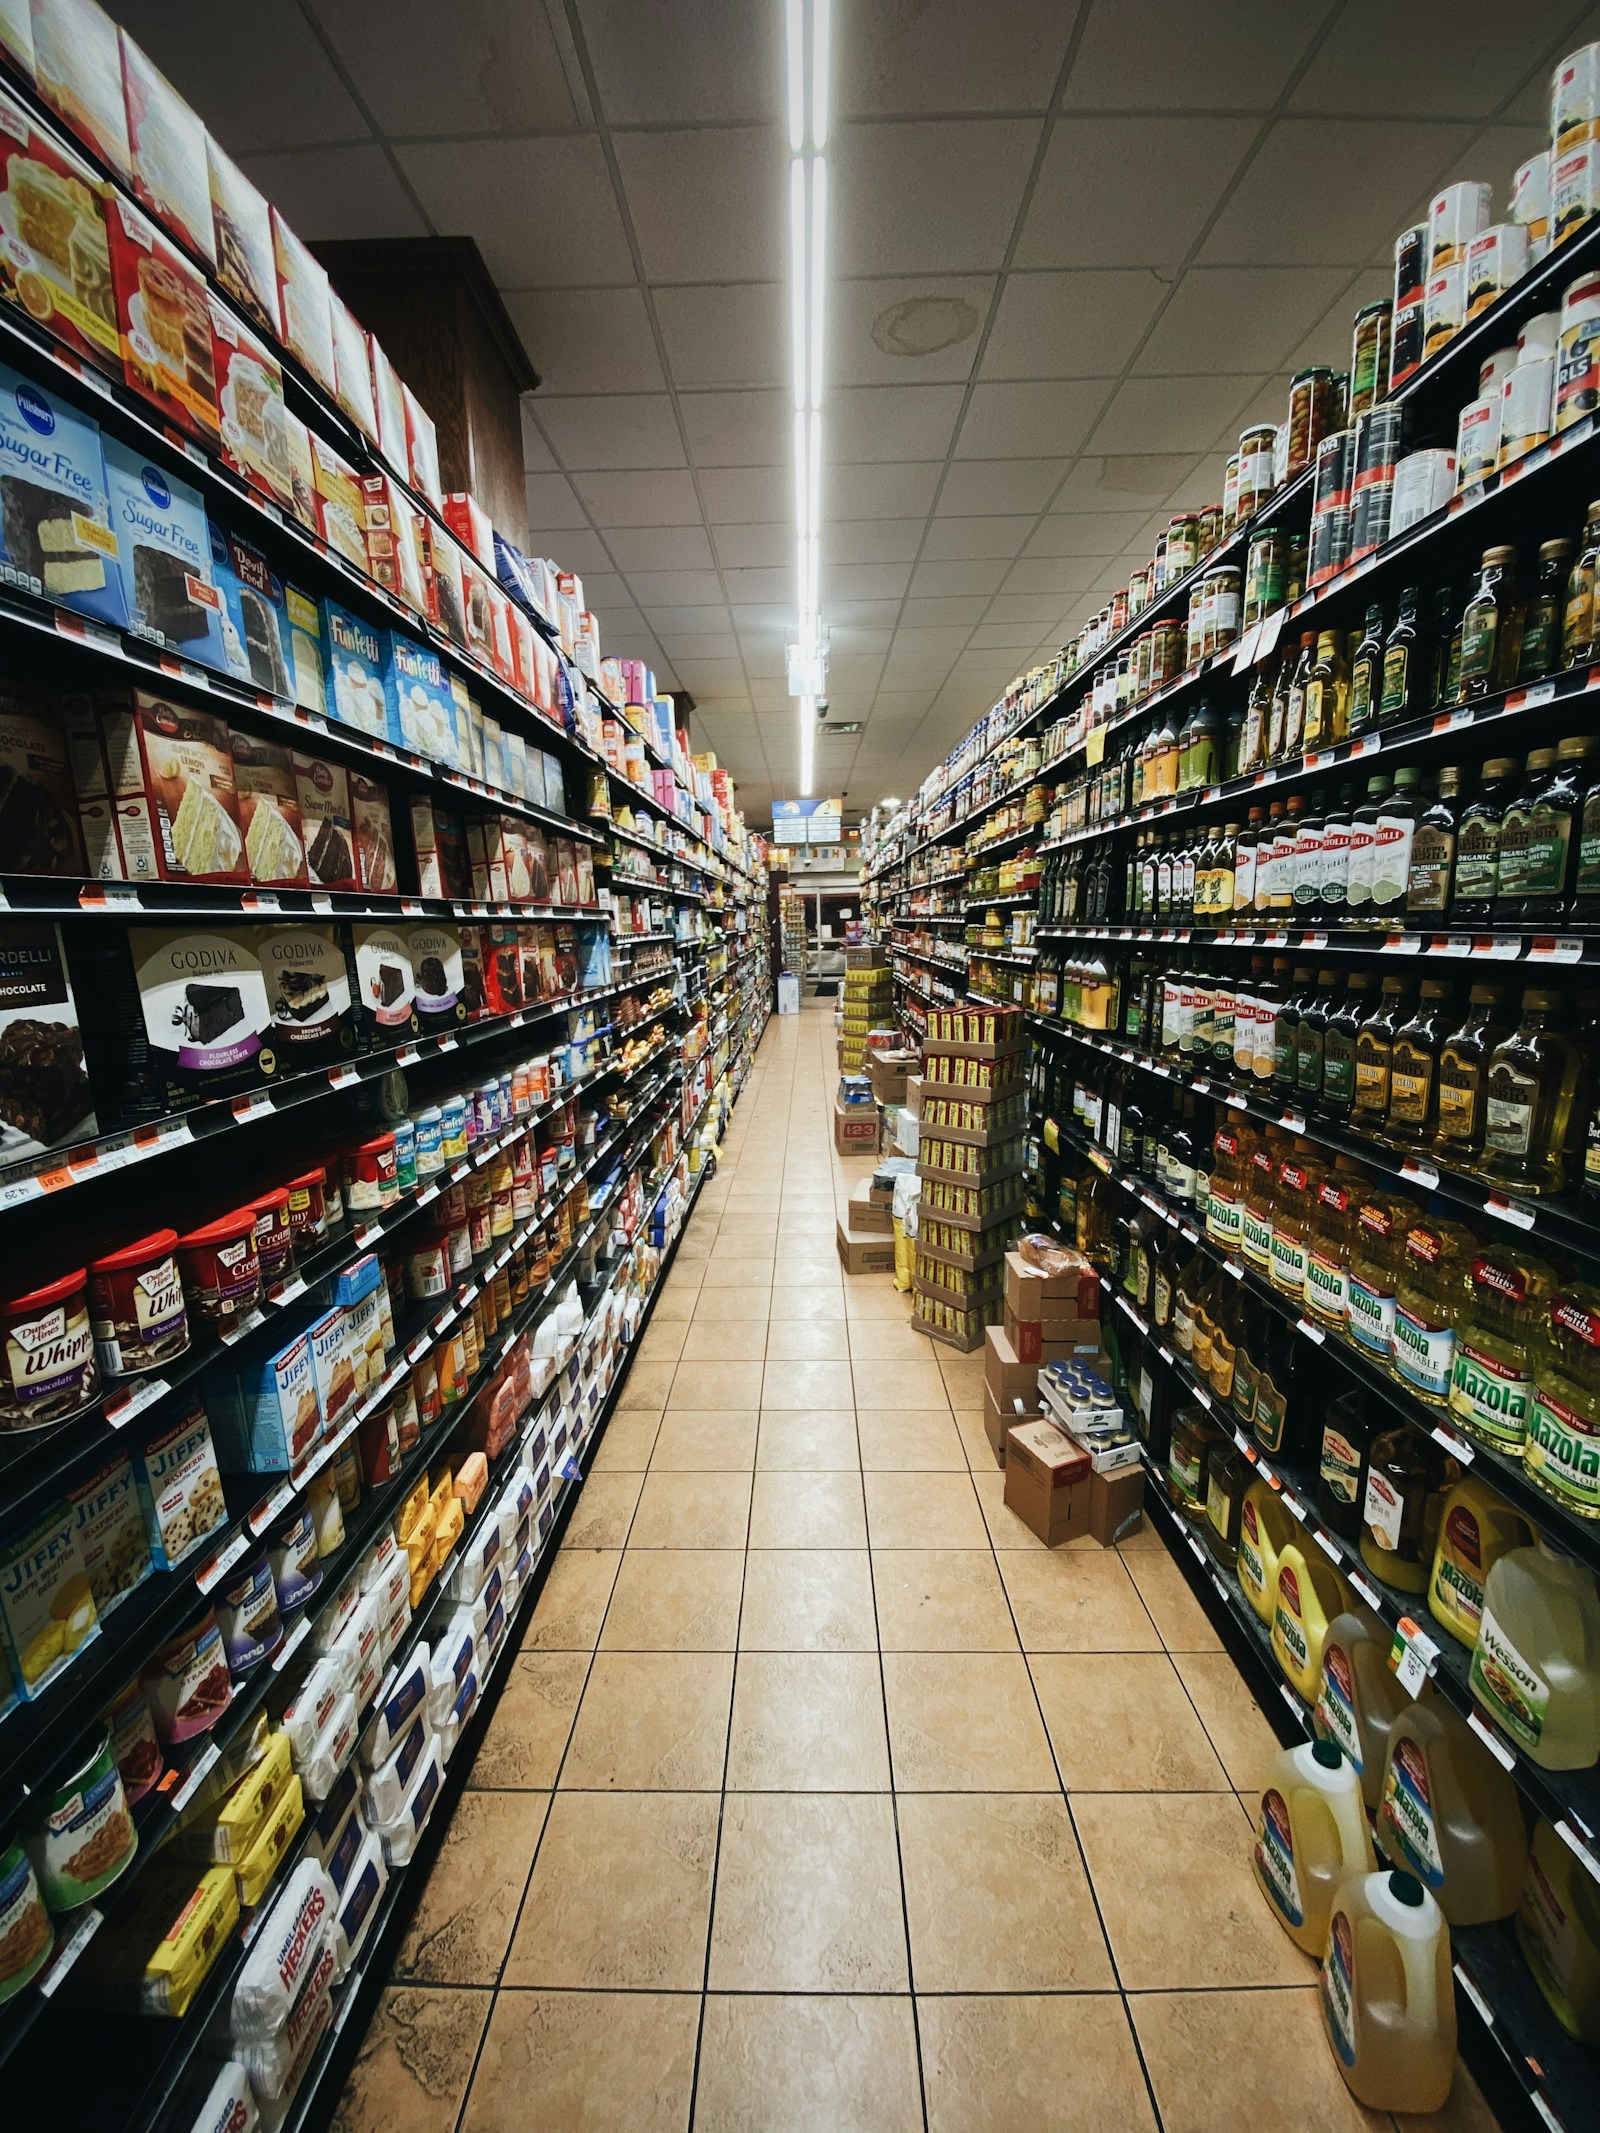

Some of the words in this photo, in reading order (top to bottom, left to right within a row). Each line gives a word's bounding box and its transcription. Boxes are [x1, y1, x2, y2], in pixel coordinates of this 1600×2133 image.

[18, 394, 54, 427] Pillsbury
[0, 422, 50, 465] Sugar
[52, 451, 93, 492] Free
[123, 500, 170, 535] Sugar
[170, 523, 201, 556] Free
[233, 546, 269, 580] Devil's
[240, 563, 264, 590] Food
[331, 613, 380, 664] Funfetti
[395, 644, 440, 687] Funfetti
[181, 756, 205, 769] LEMON
[304, 794, 325, 812] Super
[823, 803, 832, 815] 2
[1457, 853, 1492, 862] ORGANIC
[171, 949, 237, 970] GODIVA
[272, 943, 325, 961] GODIVA
[371, 941, 400, 954] GODIVA
[411, 938, 447, 950] GODIVA
[199, 1055, 231, 1067] CHOCOLATE
[231, 1049, 249, 1060] TORTE
[209, 1047, 239, 1060] FLOURLESS
[1271, 1237, 1303, 1269] Mazola
[1428, 1245, 1440, 1255] FAT
[145, 1265, 171, 1287] Duncan
[152, 1273, 171, 1291] Hines
[1307, 1259, 1343, 1297] Mazola
[1479, 1269, 1516, 1291] Healthy
[1486, 1264, 1511, 1281] Heart
[349, 1302, 376, 1330] JIFFY
[1350, 1286, 1382, 1321] Mazola
[1352, 1306, 1391, 1333] VEGETABLE
[1563, 1303, 1589, 1324] Heart
[22, 1315, 61, 1339] Duncan
[30, 1324, 60, 1345] Hines
[1394, 1316, 1430, 1357] Mazola
[1556, 1309, 1594, 1334] Healthy
[316, 1324, 346, 1357] JIFFY
[1397, 1340, 1440, 1371] VEGETABLE
[280, 1353, 310, 1391] JIFFY
[1464, 1345, 1498, 1371] Cholesterol
[1499, 1366, 1516, 1379] Free
[29, 1373, 74, 1396] Chocolate
[1454, 1356, 1527, 1420] Mazola
[1472, 1401, 1506, 1426] CANOLA
[1508, 1418, 1527, 1430] OIL
[1540, 1392, 1573, 1422] Cholesterol
[1572, 1415, 1589, 1431] Free
[147, 1427, 180, 1454] Compare
[151, 1425, 208, 1478] JIFFY
[1529, 1402, 1600, 1478] Mazola
[164, 1451, 206, 1488] RASPBERRY
[1545, 1453, 1579, 1482] CANOLA
[1579, 1475, 1599, 1488] OIL
[75, 1472, 131, 1530] JIFFY
[1370, 1476, 1396, 1507] BERTOLLI
[82, 1500, 130, 1540] RASPBERRY
[3, 1524, 72, 1594] JIFFY
[1441, 1558, 1484, 1609] Mazola
[1277, 1604, 1306, 1661] Mazola
[1408, 1652, 1422, 1669] SALE
[1484, 1628, 1538, 1693] Wesson
[1395, 1784, 1429, 1841] Mazola
[276, 1884, 315, 1965] UNBLEACHED
[278, 1887, 327, 1993] HECKERS
[286, 1948, 335, 2051] HECKERS
